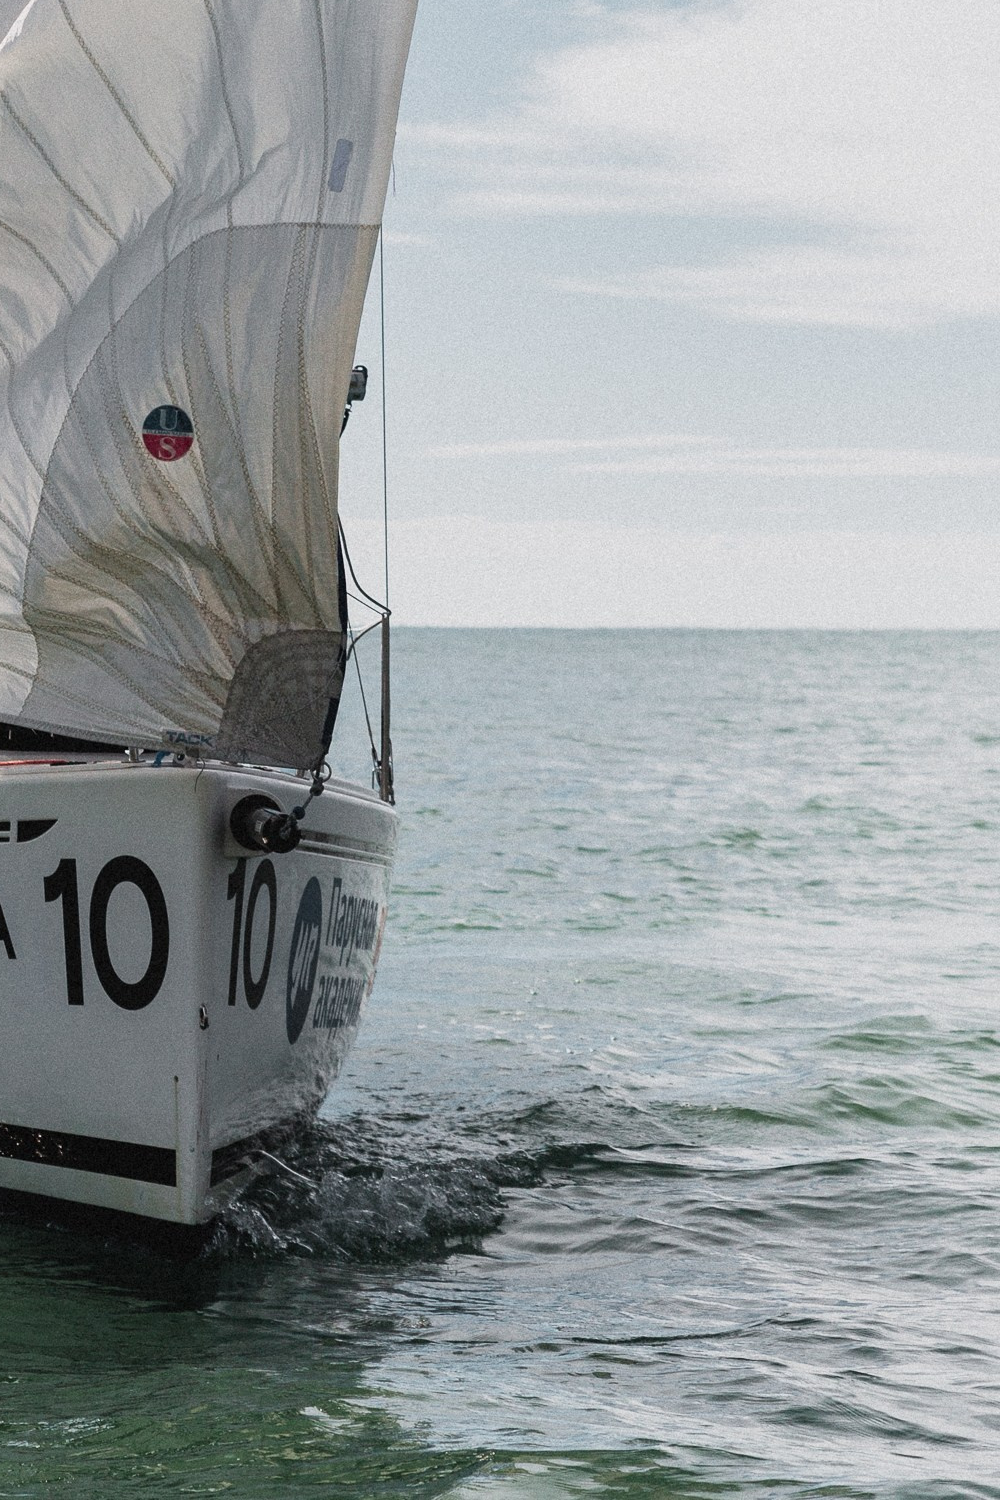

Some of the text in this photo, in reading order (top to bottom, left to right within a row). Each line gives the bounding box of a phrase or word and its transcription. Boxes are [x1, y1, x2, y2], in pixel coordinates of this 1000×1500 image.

[166, 730, 213, 748] TACK
[43, 854, 170, 1011] 10
[227, 857, 277, 1011] 10
